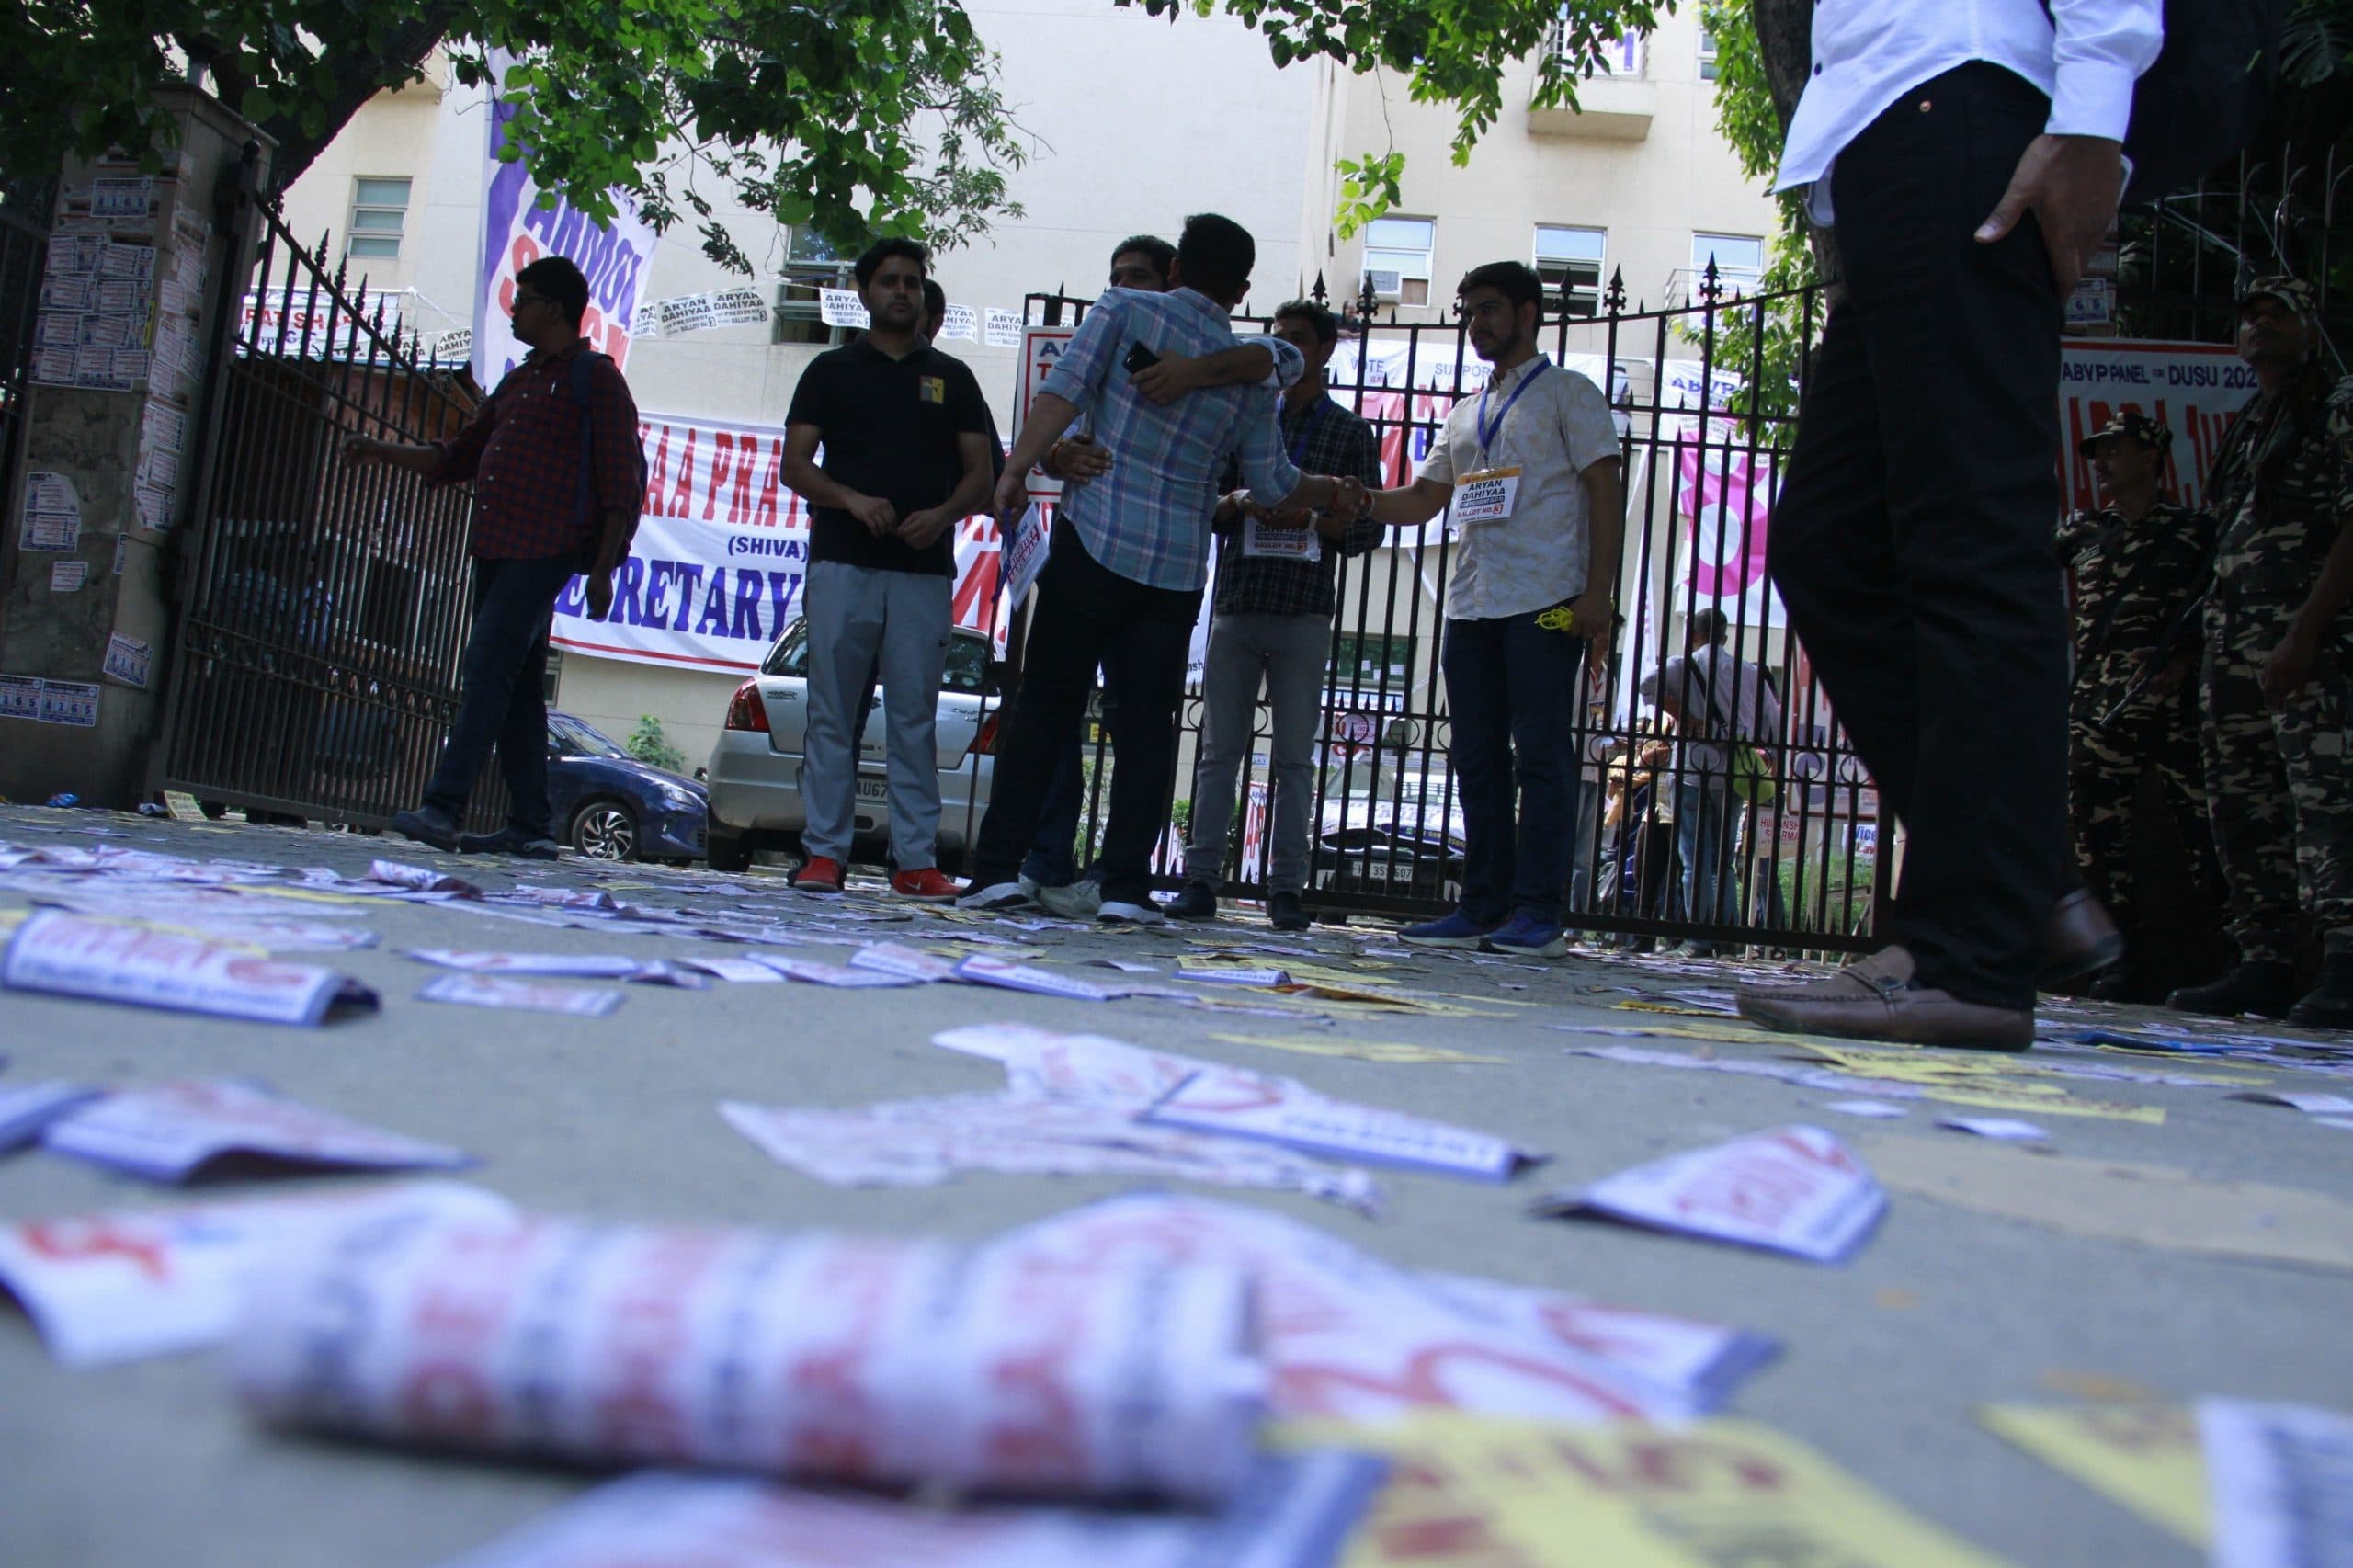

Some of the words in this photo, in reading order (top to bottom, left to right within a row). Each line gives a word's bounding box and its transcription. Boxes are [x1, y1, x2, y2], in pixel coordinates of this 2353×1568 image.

[717, 291, 759, 302] ARYAN
[825, 294, 859, 303] ARYA
[664, 298, 707, 313] ARYAN
[713, 299, 765, 311] DAHIYAA
[823, 301, 863, 312] DAHIYA
[661, 305, 711, 323] DAHIYAA
[991, 315, 1022, 324] ARYA
[439, 330, 471, 344] ARYA
[437, 338, 471, 353] DAHIY
[2063, 363, 2108, 382] ABVP
[2111, 365, 2150, 384] PANEL
[2169, 366, 2218, 386] DUSU
[2223, 366, 2258, 389] 202
[1468, 479, 1503, 493] ARYAN
[1461, 487, 1506, 501] DAHIYAA
[727, 536, 809, 562] (SHIVA)
